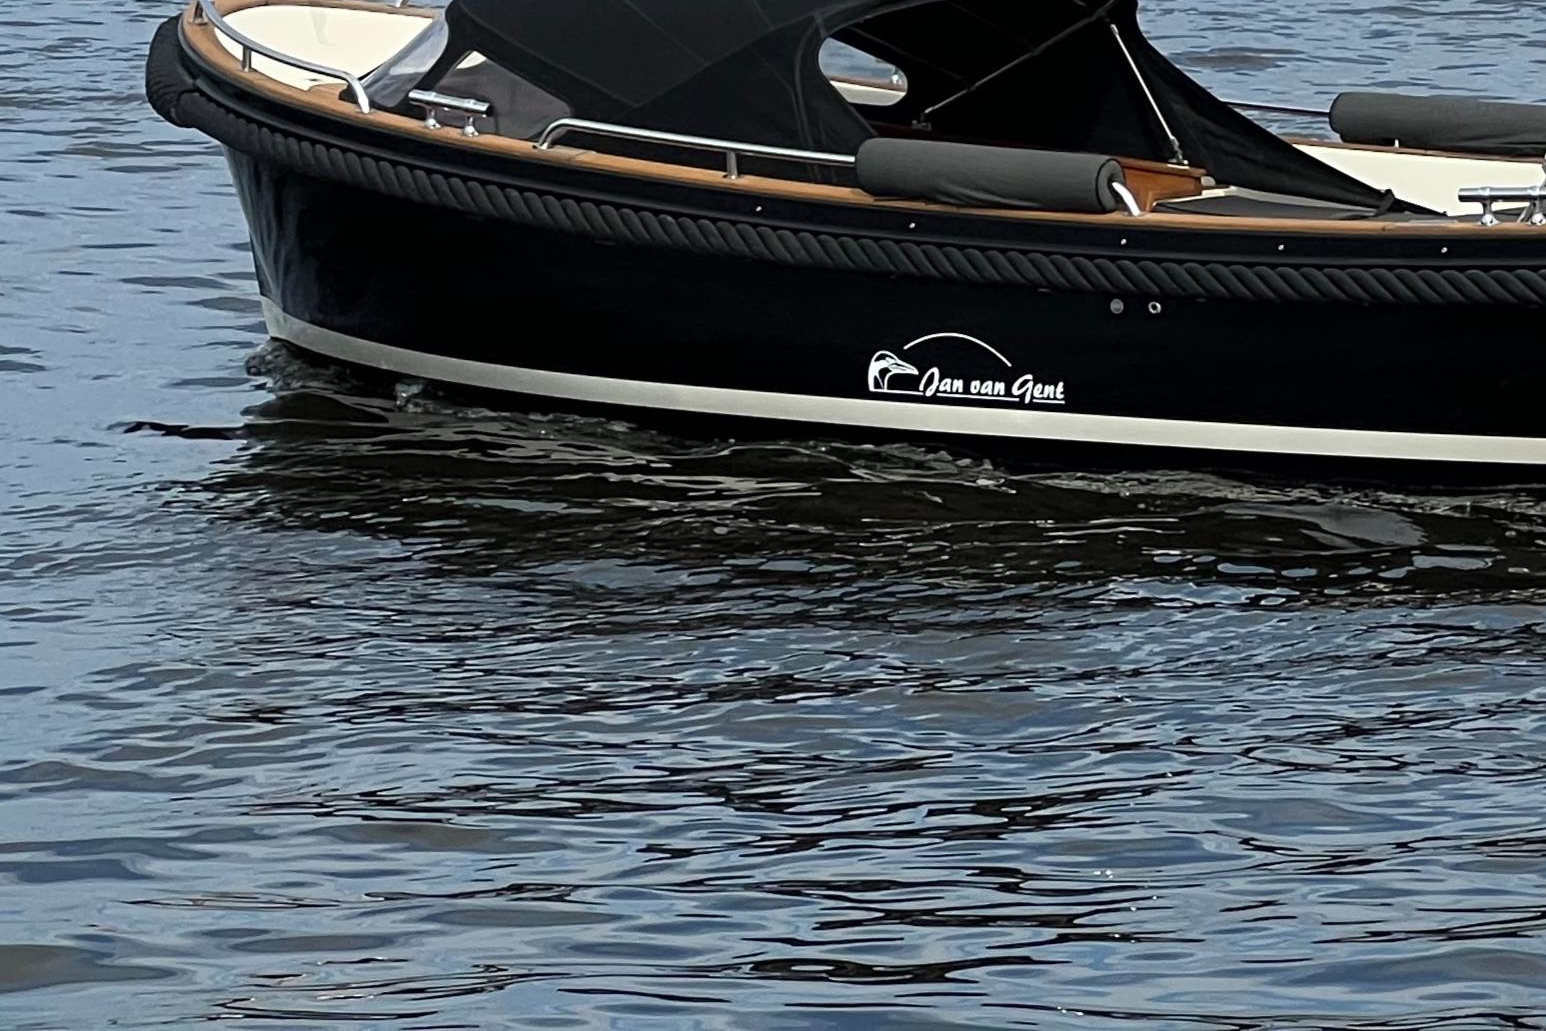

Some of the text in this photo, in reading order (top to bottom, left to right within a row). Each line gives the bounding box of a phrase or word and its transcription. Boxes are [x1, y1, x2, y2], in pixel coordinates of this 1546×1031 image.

[919, 366, 1065, 404] Jan van Gent
